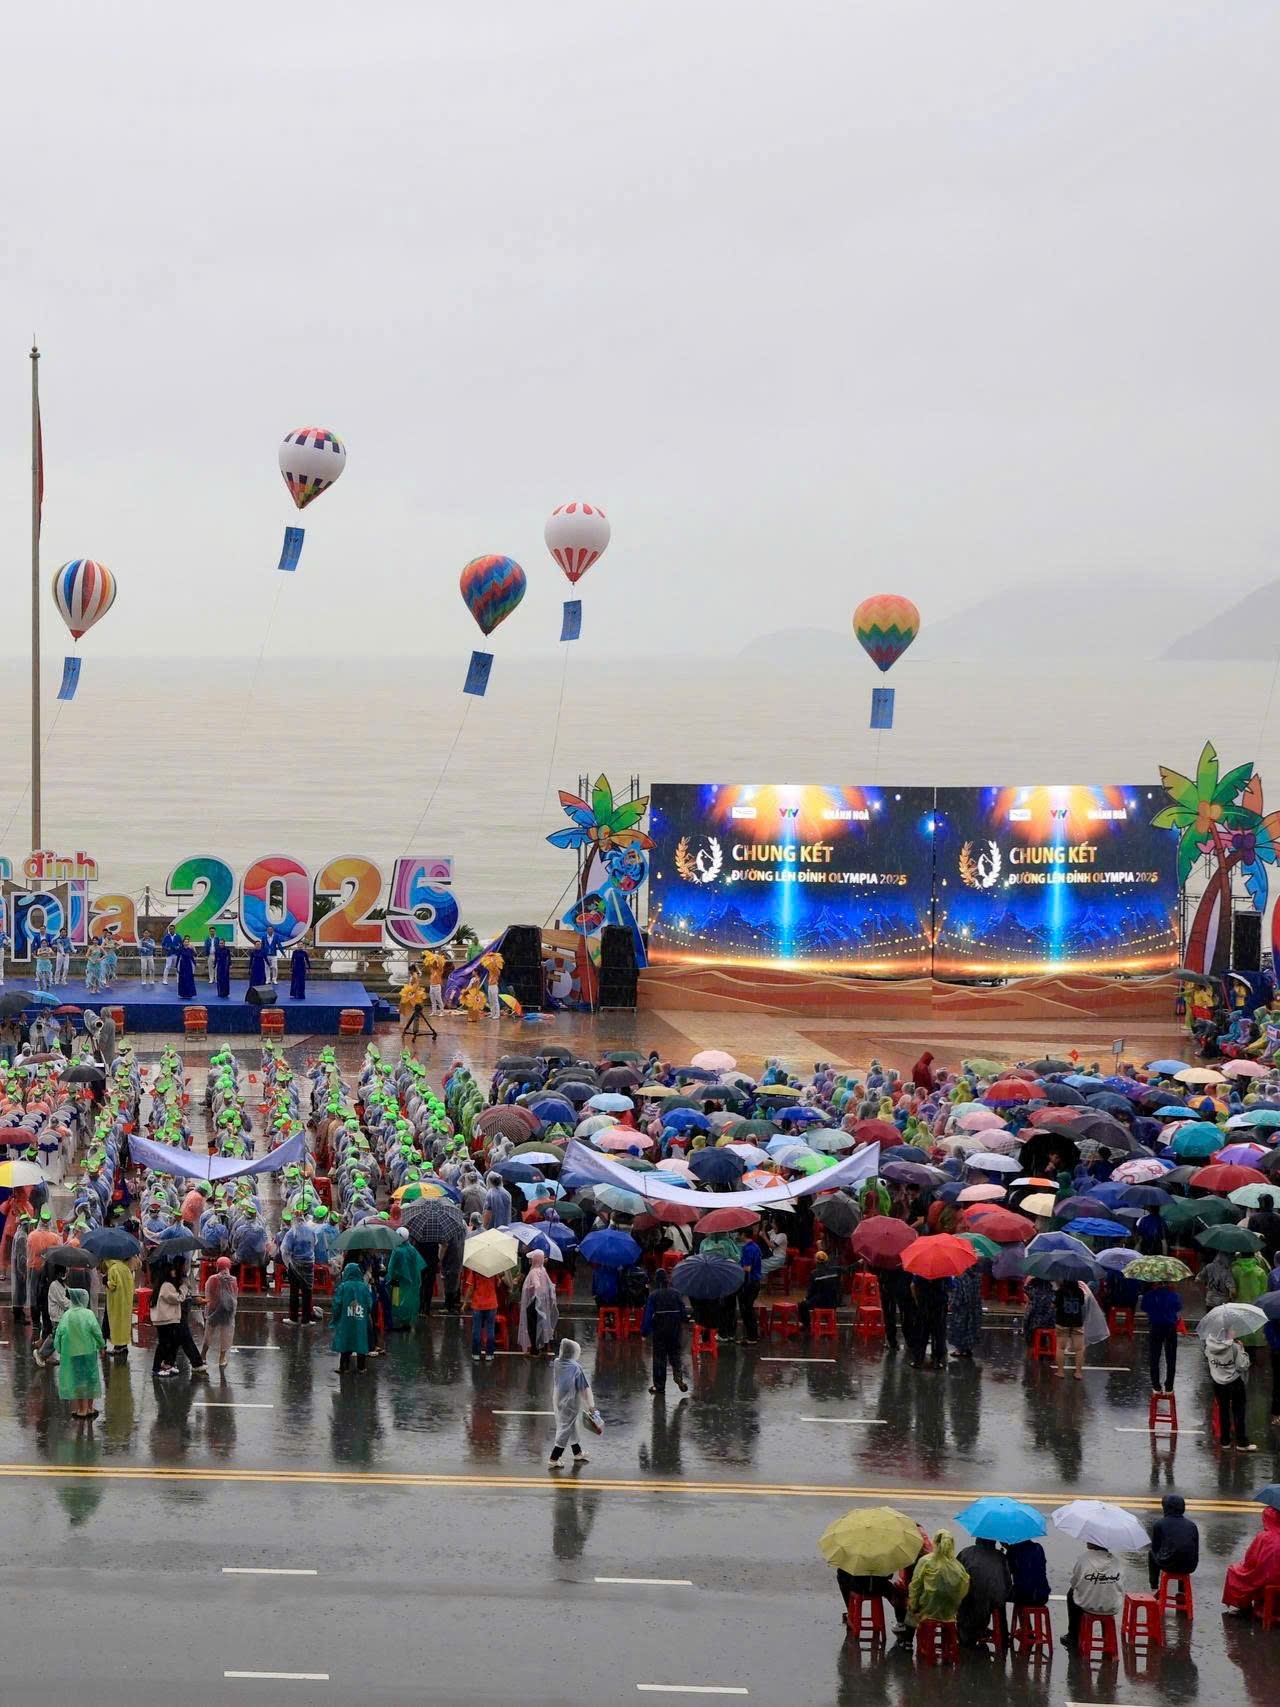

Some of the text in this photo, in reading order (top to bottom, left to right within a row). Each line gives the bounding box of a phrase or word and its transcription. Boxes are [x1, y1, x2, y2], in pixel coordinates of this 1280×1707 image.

[778, 808, 799, 818] VTV
[1050, 809, 1067, 819] VTV
[732, 841, 834, 863] CHUNG KẾT
[1009, 841, 1097, 864] CHUNG KẾT
[23, 849, 98, 881] đỉnh
[828, 871, 878, 884] OLYMPIA
[1093, 871, 1134, 883] OLYMPIA
[166, 853, 462, 949] 2025
